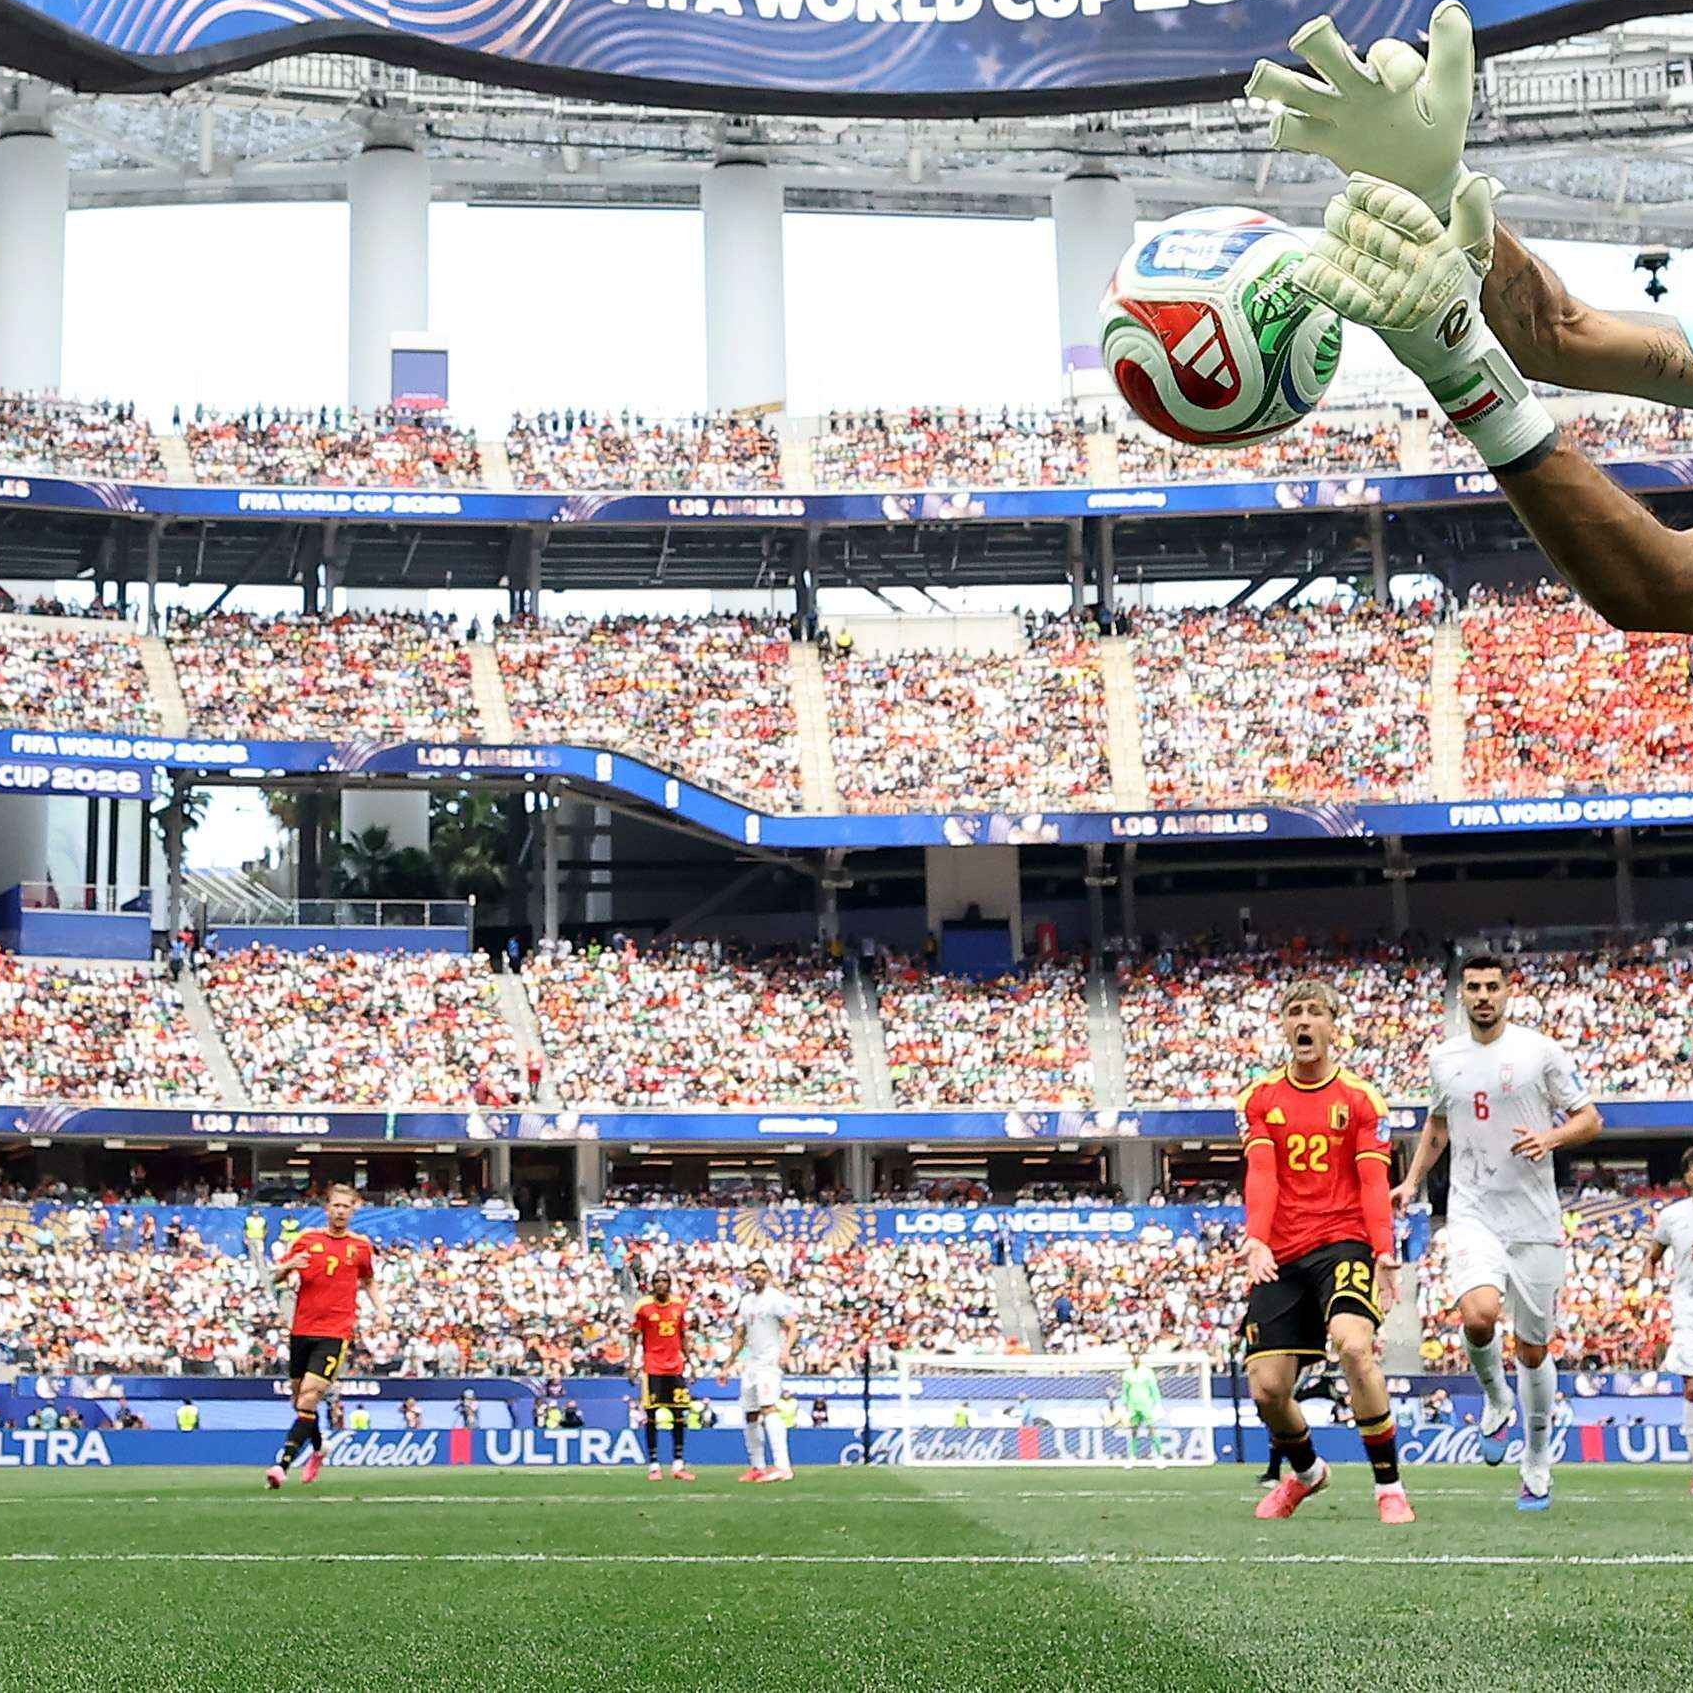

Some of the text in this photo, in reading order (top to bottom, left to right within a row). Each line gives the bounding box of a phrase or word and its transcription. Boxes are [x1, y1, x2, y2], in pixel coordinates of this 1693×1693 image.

[416, 747, 462, 767] LOS
[52, 767, 143, 793] 2026
[1111, 816, 1158, 836] LOS
[1474, 1091, 1490, 1120] 6
[191, 1114, 232, 1132] LOS
[1287, 1133, 1330, 1173] 22
[896, 1211, 1135, 1234] LOS ANGELES
[327, 1255, 339, 1276] 7
[1334, 1260, 1371, 1293] 22
[486, 1428, 647, 1465] ULTRA
